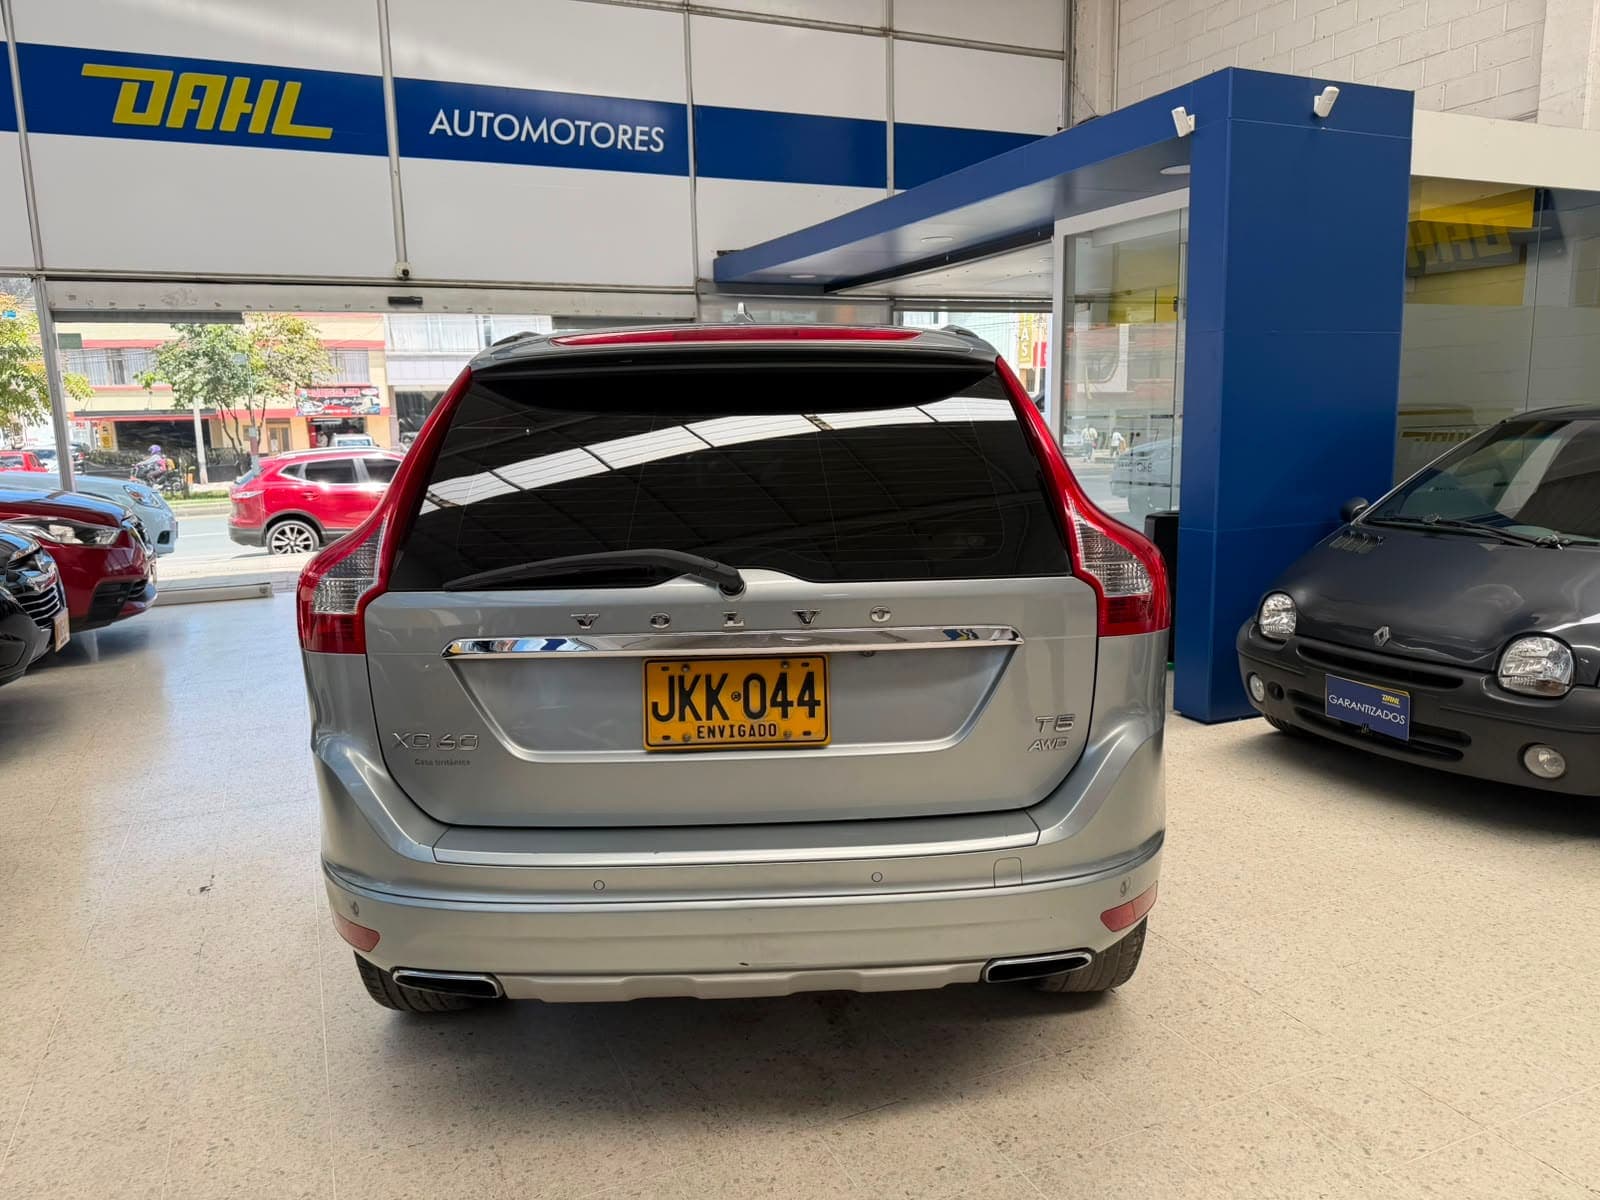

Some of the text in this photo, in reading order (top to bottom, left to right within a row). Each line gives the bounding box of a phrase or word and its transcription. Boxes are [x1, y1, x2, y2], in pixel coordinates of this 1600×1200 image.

[81, 63, 333, 139] DAHL
[429, 108, 665, 153] AUTOMOTORES
[570, 605, 893, 629] VOLVO
[652, 671, 822, 722] JKK 044
[1328, 694, 1406, 725] GARANTIZADOS
[696, 723, 778, 740] ENVIGADO
[1035, 714, 1075, 733] T5
[1027, 736, 1070, 752] AWD
